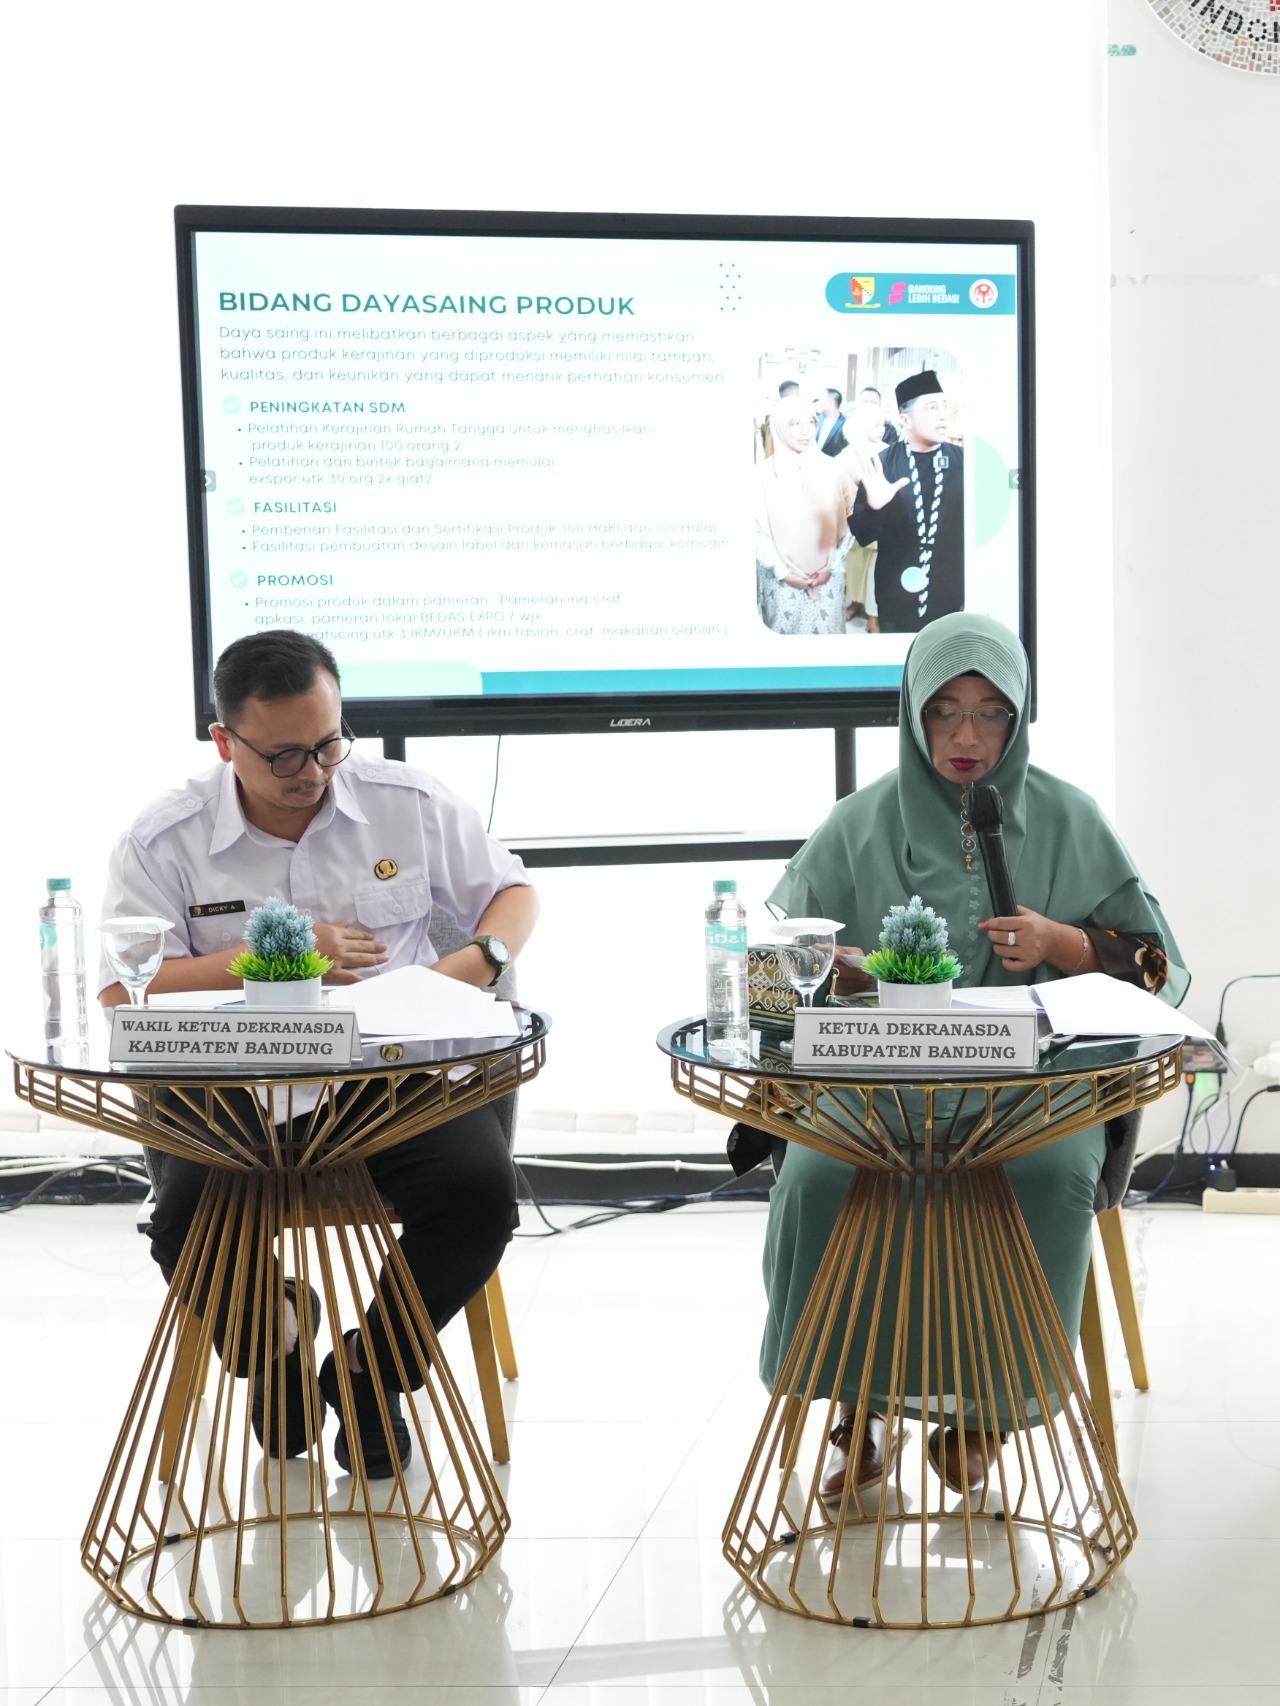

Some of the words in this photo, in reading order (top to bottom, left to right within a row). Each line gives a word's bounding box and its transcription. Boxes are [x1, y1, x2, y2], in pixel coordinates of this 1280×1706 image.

[908, 284, 947, 294] BANDUNG
[219, 291, 332, 313] BIDANG
[341, 293, 507, 315] DAYASAING
[516, 295, 635, 316] PRODUK
[908, 294, 931, 303] LEBIH
[219, 326, 261, 342] Daya
[266, 328, 310, 342] saing
[314, 329, 333, 339] ini
[337, 327, 427, 341] melibatkan
[431, 328, 503, 344] berbagai
[507, 329, 554, 344] aspek
[558, 332, 597, 345] yang
[601, 330, 695, 343] memastikan
[219, 346, 276, 360] bahwa
[281, 347, 337, 362] produk
[341, 348, 416, 363] kerajinan
[420, 351, 460, 364] yang
[463, 349, 545, 364] diproduksi
[549, 350, 611, 362] memiliki
[615, 351, 647, 363] nilai
[292, 368, 324, 381] dan
[328, 368, 399, 382] keunikan
[404, 371, 444, 385] yang
[448, 370, 497, 385] dapat
[501, 370, 563, 384] menarik
[567, 371, 643, 385] perhatian
[249, 400, 365, 414] PENINGKATAN
[368, 401, 406, 414] SDM
[247, 422, 318, 434] Pelatihan
[322, 423, 392, 436] Kerajinan
[395, 423, 446, 434] Rumah
[450, 423, 505, 437] Tangga
[509, 423, 549, 435] untuk
[552, 423, 651, 438] menghasilkan
[251, 439, 303, 453] produk
[307, 439, 376, 453] kerajinan
[381, 440, 403, 451] 100
[406, 441, 450, 454] orang
[249, 456, 319, 468] Pelatihan
[323, 456, 352, 468] dan
[356, 456, 401, 468] bintek
[405, 456, 491, 470] bagaimana
[493, 456, 555, 468] memulai
[253, 501, 337, 514] FASILITASI
[252, 540, 316, 553] Fasilitasi
[319, 540, 406, 554] pembuatan
[409, 540, 458, 552] desain
[462, 539, 497, 552] label
[501, 540, 529, 551] dan
[533, 539, 597, 550] kemasan
[601, 538, 666, 552] berbagai
[669, 537, 729, 550] komoditi
[257, 574, 334, 587] PROMOSI
[255, 596, 313, 608] Promosi
[317, 595, 368, 609] produk
[372, 595, 419, 607] dalam
[423, 596, 489, 608] pameran
[499, 593, 563, 606] Pameran
[311, 614, 378, 626] pameran
[382, 612, 416, 623] lokal
[420, 611, 465, 623] BEDAS
[469, 611, 505, 623] EXPO
[208, 905, 228, 913] DICKY
[121, 1020, 173, 1032] WAKIL
[177, 1021, 231, 1033] KETUA
[236, 1022, 345, 1034] DEKRANASDA
[818, 1022, 880, 1035] KETUA
[886, 1023, 1012, 1036] DEKRANASDA
[127, 1040, 239, 1053] KABUPATEN
[244, 1041, 333, 1055] BANDUNG
[811, 1044, 922, 1057] KABUPATEN
[927, 1045, 1016, 1059] BANDUNG
